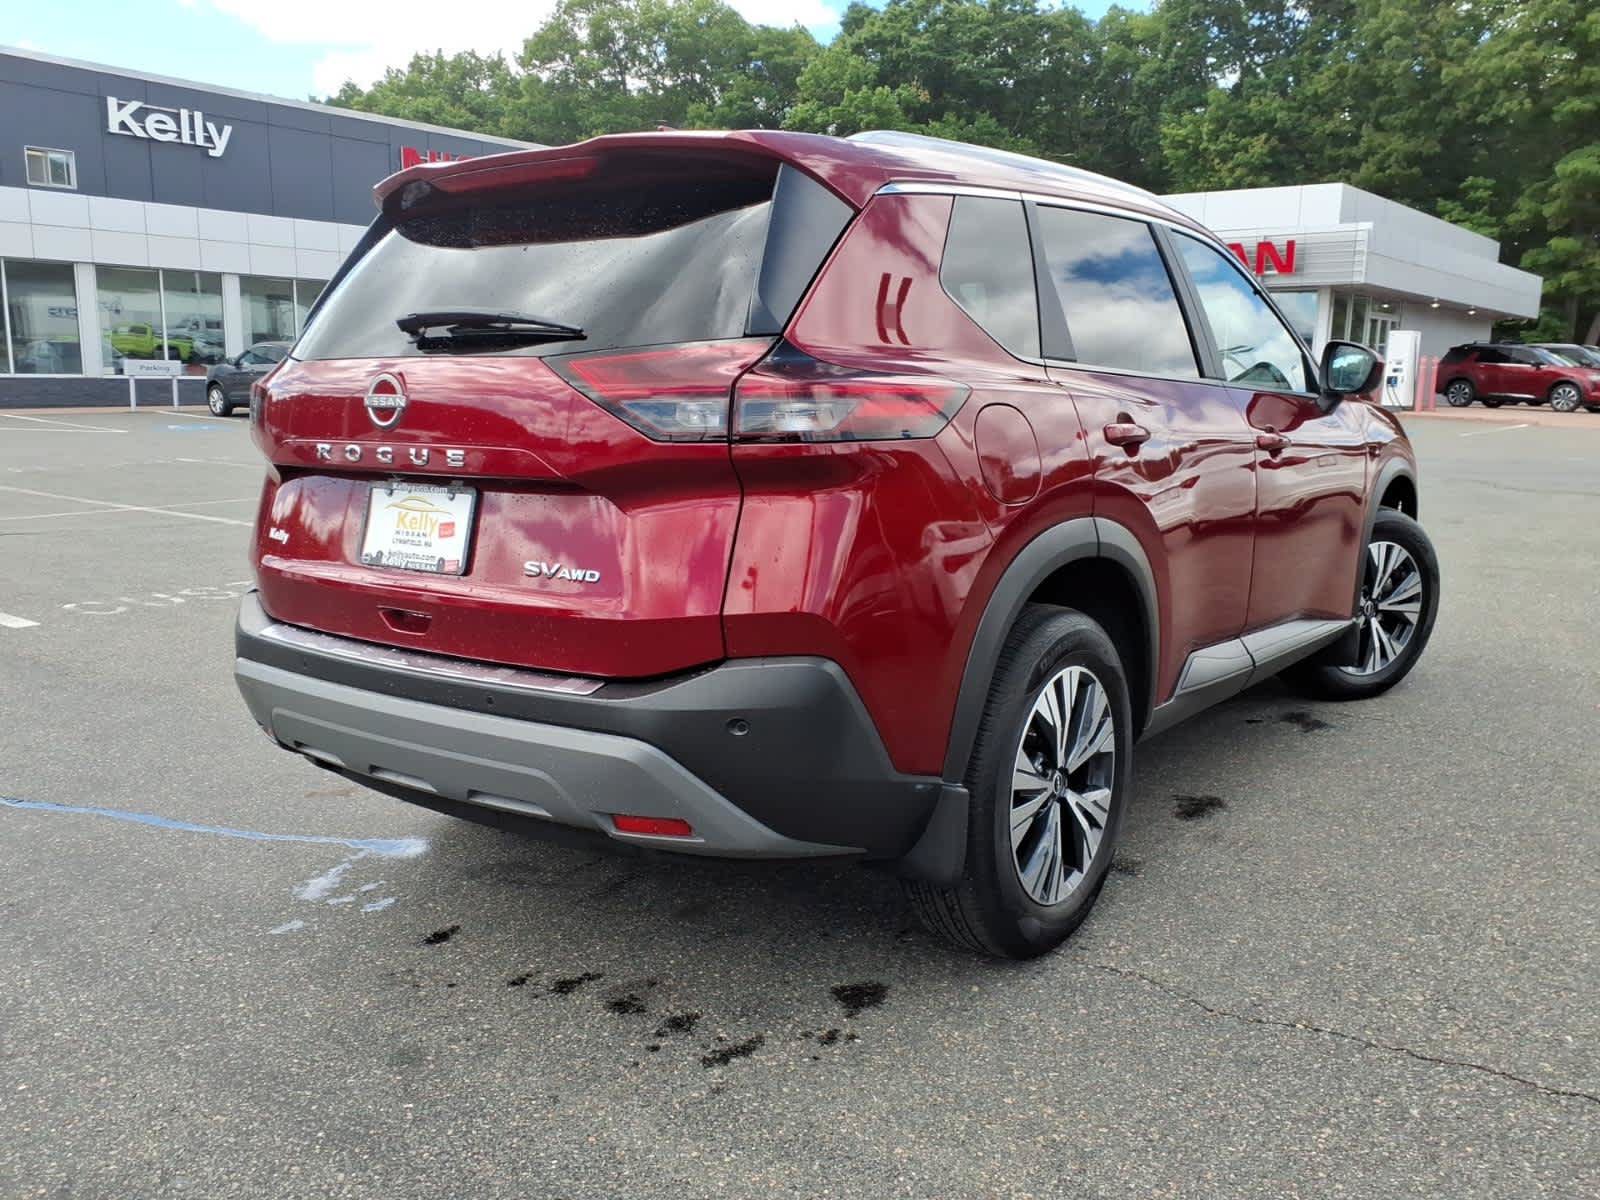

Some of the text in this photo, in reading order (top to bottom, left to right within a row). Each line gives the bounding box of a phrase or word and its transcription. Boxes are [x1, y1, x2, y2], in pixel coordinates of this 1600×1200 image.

[106, 96, 232, 157] Kelly
[366, 395, 406, 407] NISSAN
[316, 443, 465, 467] ROGUE
[397, 512, 437, 541] Kelly
